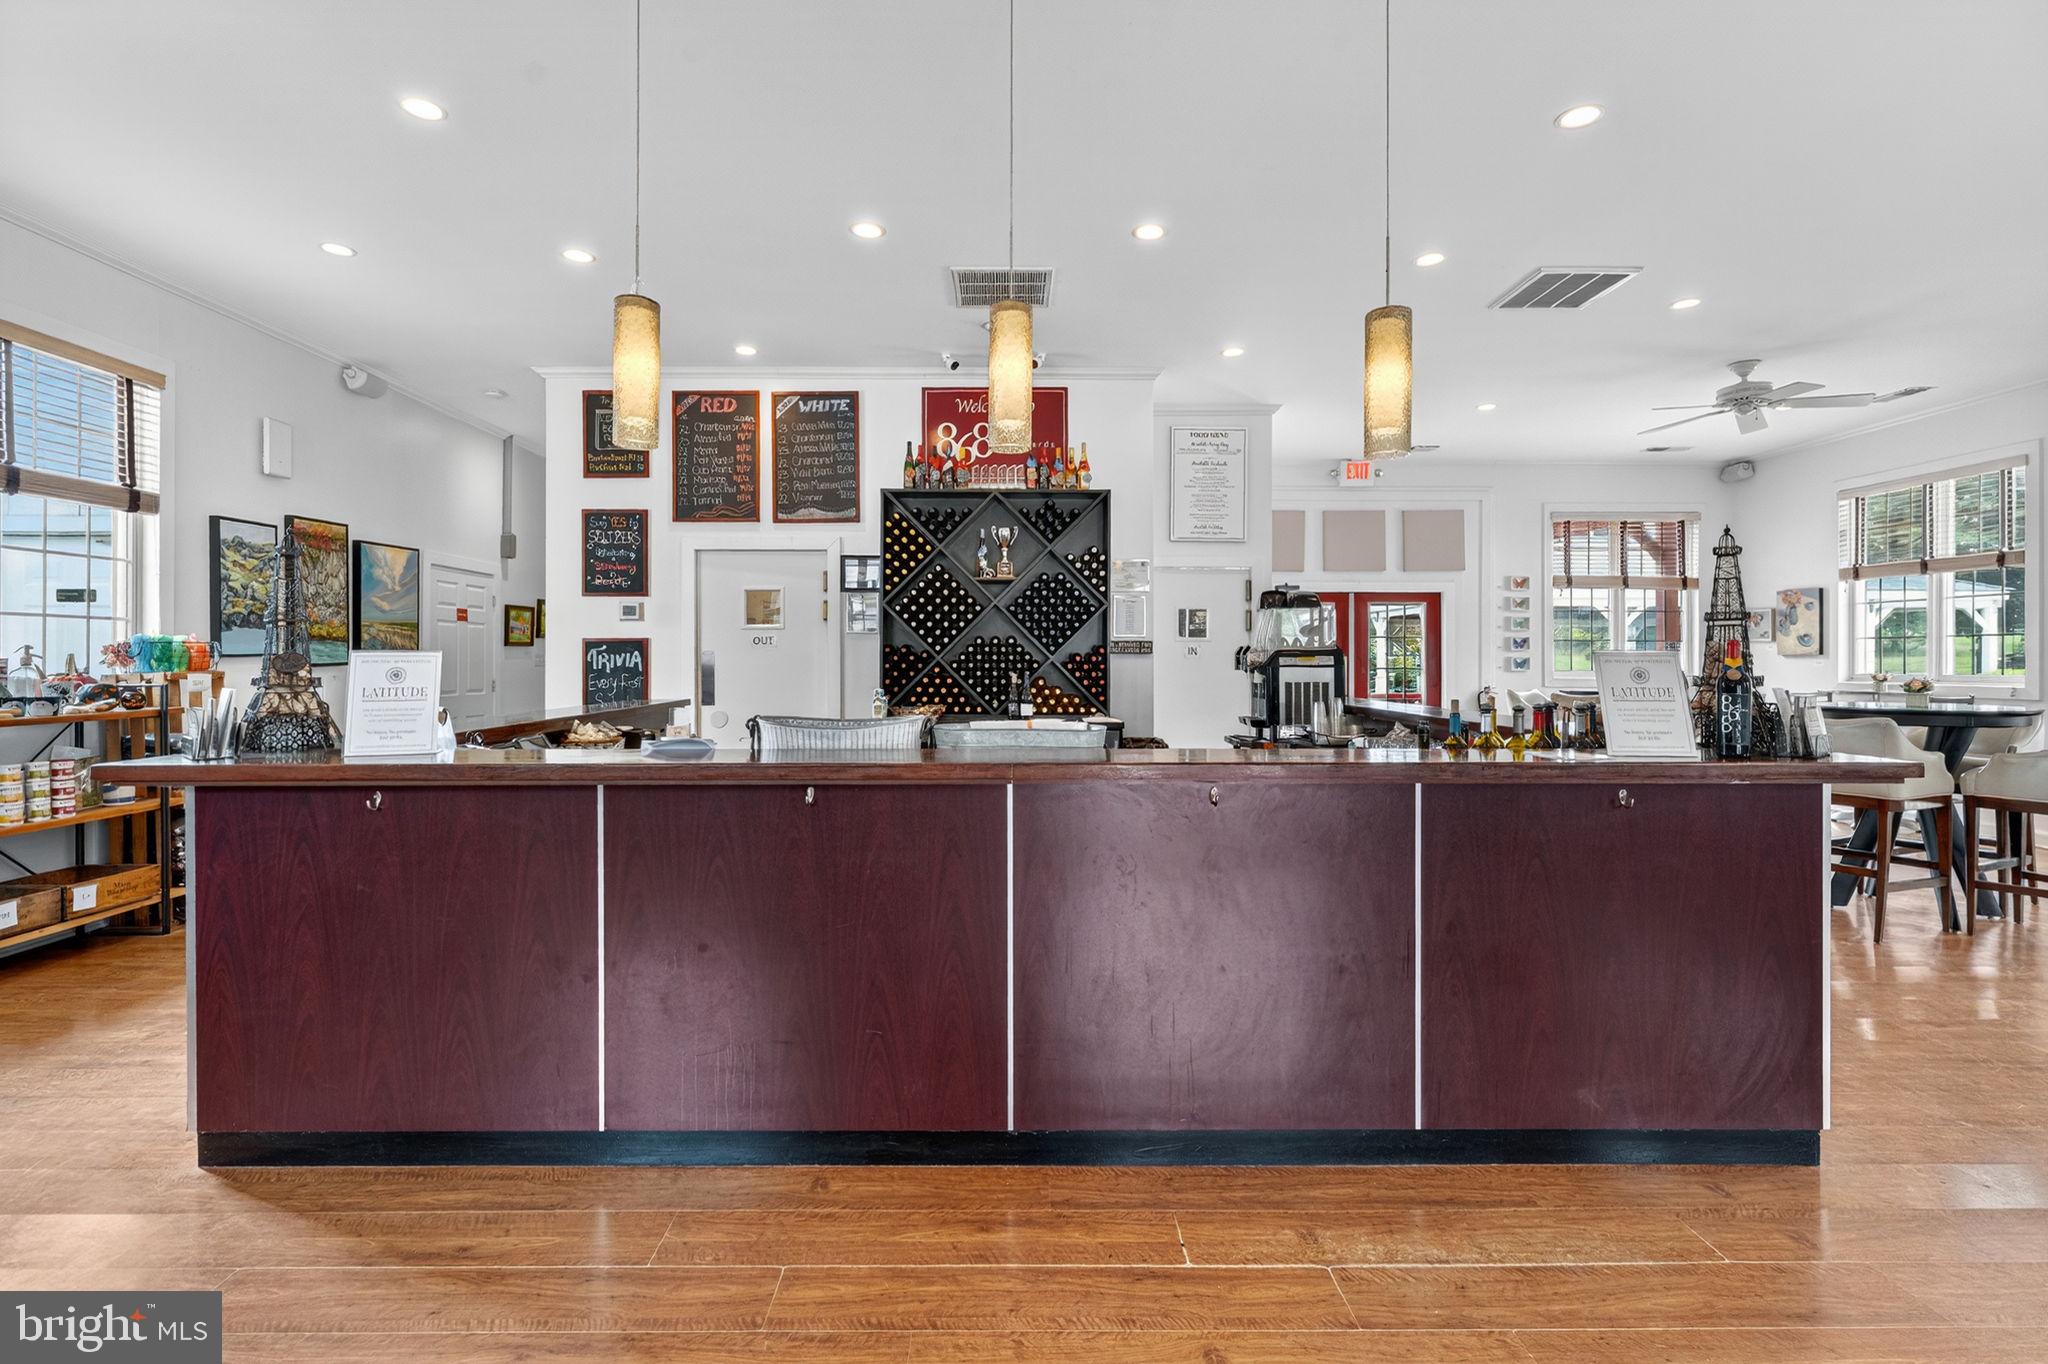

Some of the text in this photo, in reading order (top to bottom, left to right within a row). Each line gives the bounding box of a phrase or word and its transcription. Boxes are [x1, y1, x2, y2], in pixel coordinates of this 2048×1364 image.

[700, 396, 737, 413] RED
[799, 399, 850, 412] WHITE
[954, 394, 989, 413] Welc
[936, 422, 993, 465] 868
[1347, 463, 1369, 479] EXIT
[609, 516, 627, 528] YES
[752, 636, 775, 645] OUT
[1187, 646, 1198, 655] IN
[587, 645, 642, 673] TRIVIA
[361, 686, 429, 699] LATITUDE
[1611, 686, 1676, 698] LATITUDE
